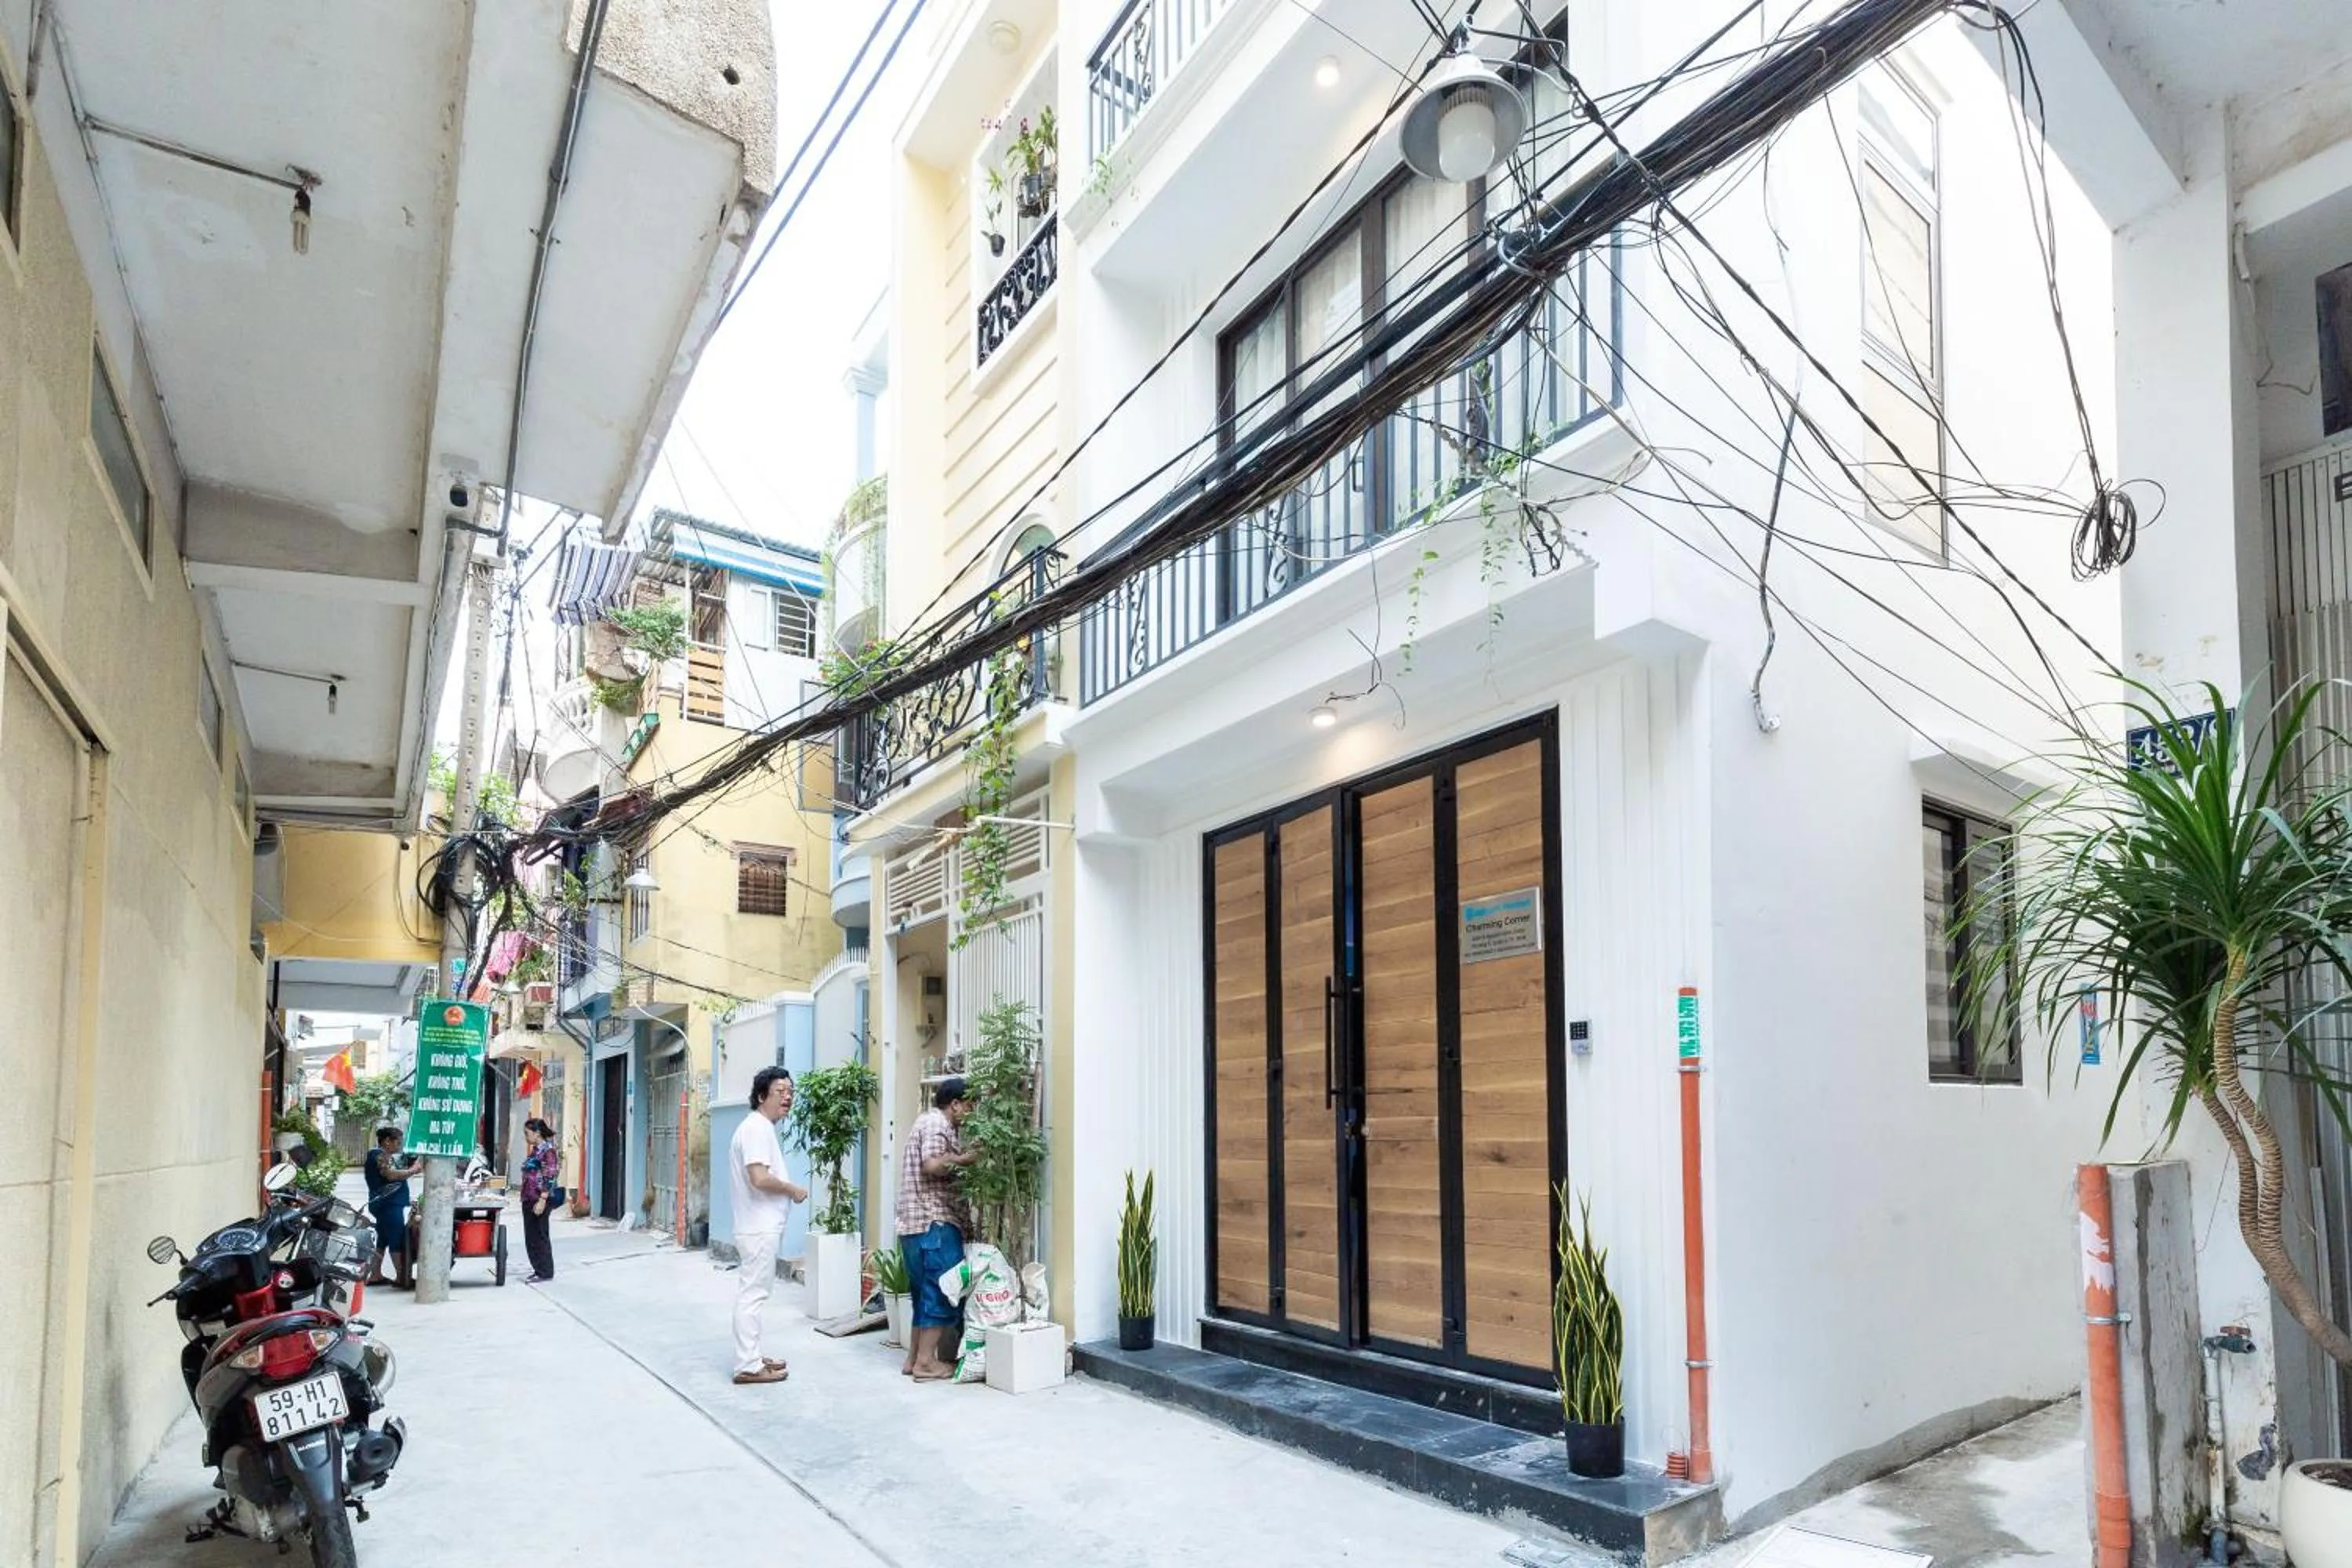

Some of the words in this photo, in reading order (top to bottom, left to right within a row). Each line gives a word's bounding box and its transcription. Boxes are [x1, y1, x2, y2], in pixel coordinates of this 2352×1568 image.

[1465, 920, 1503, 933] Charming
[1504, 914, 1531, 926] Corner
[269, 1380, 327, 1412] 59-H1
[266, 1398, 342, 1436] 811.42
